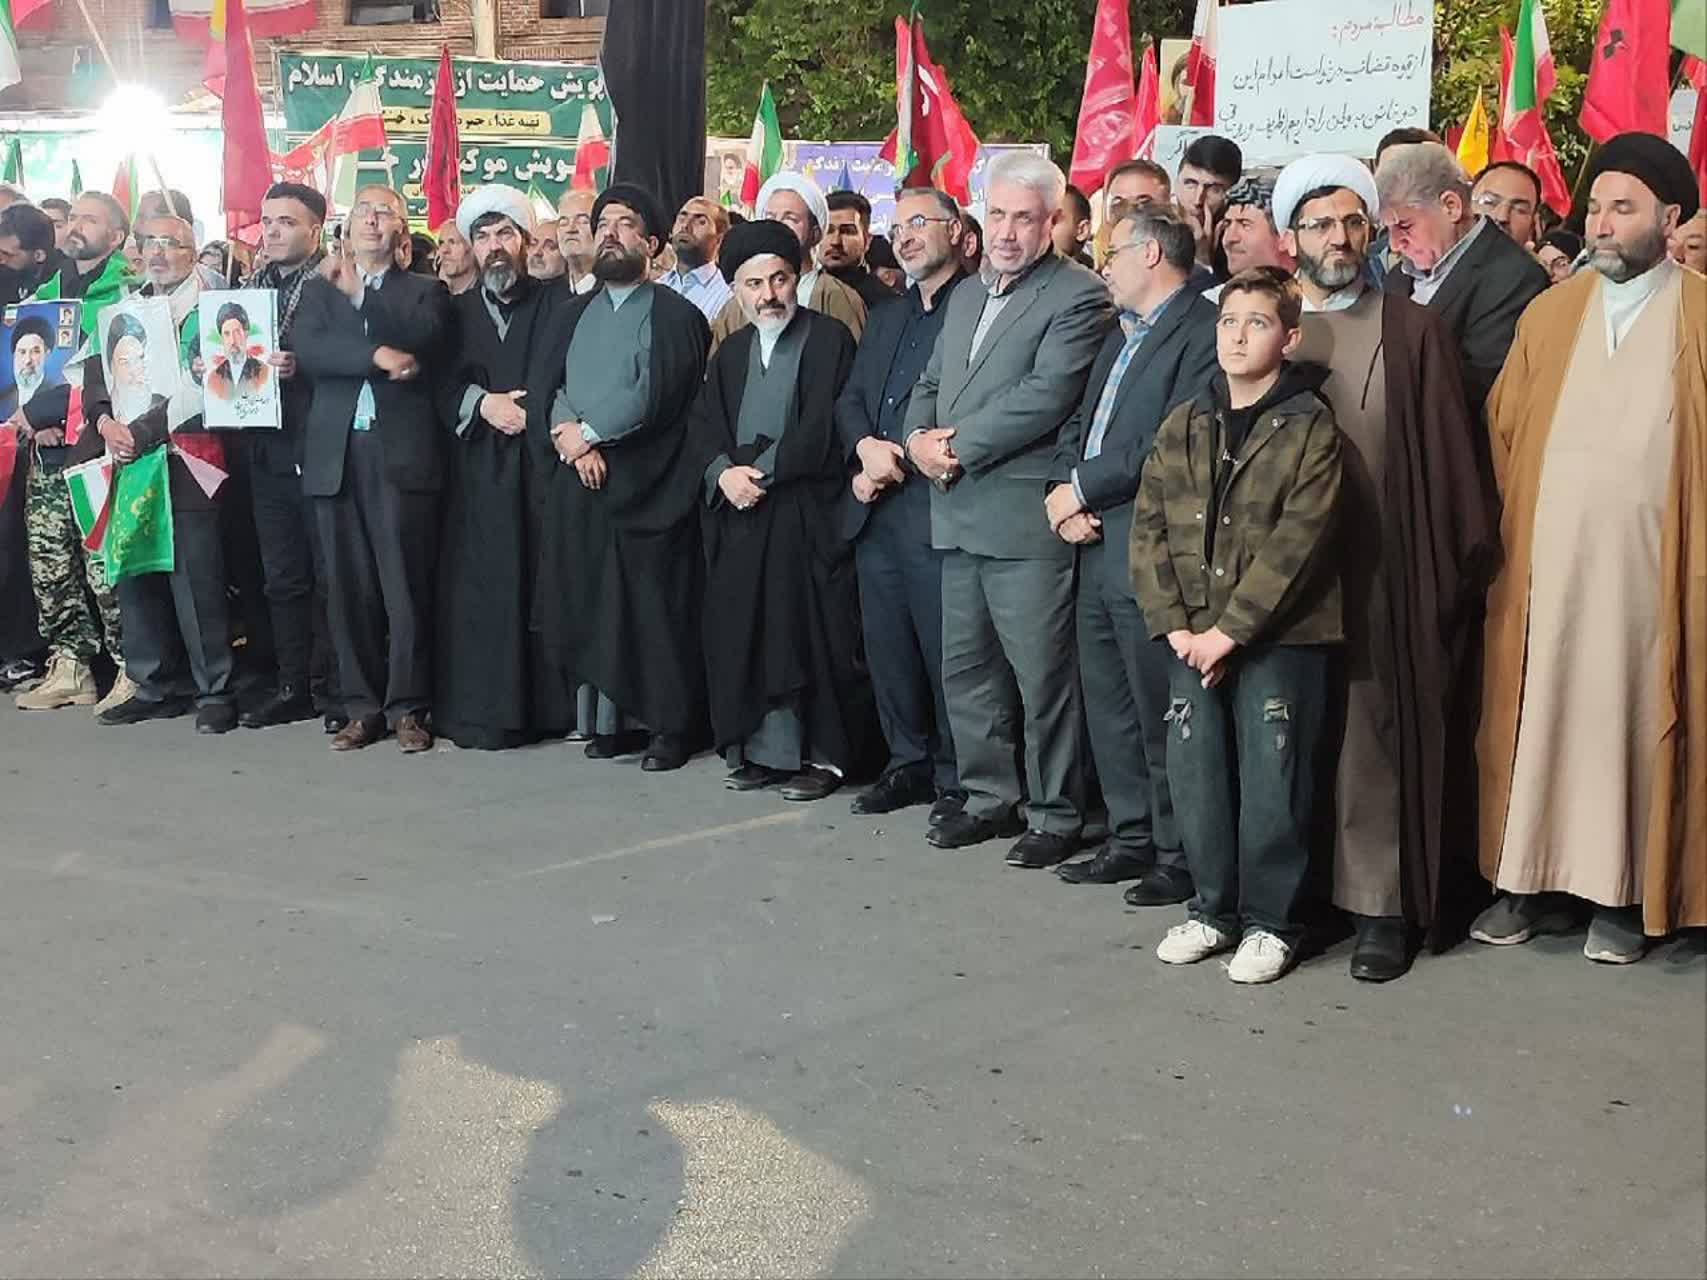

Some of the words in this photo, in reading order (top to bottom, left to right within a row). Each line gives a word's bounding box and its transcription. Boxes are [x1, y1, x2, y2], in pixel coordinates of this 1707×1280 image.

[288, 61, 344, 93] اسلام
[455, 67, 473, 97] از
[478, 69, 545, 97] حمایت
[551, 71, 605, 100] پویش
[461, 149, 509, 181] موک
